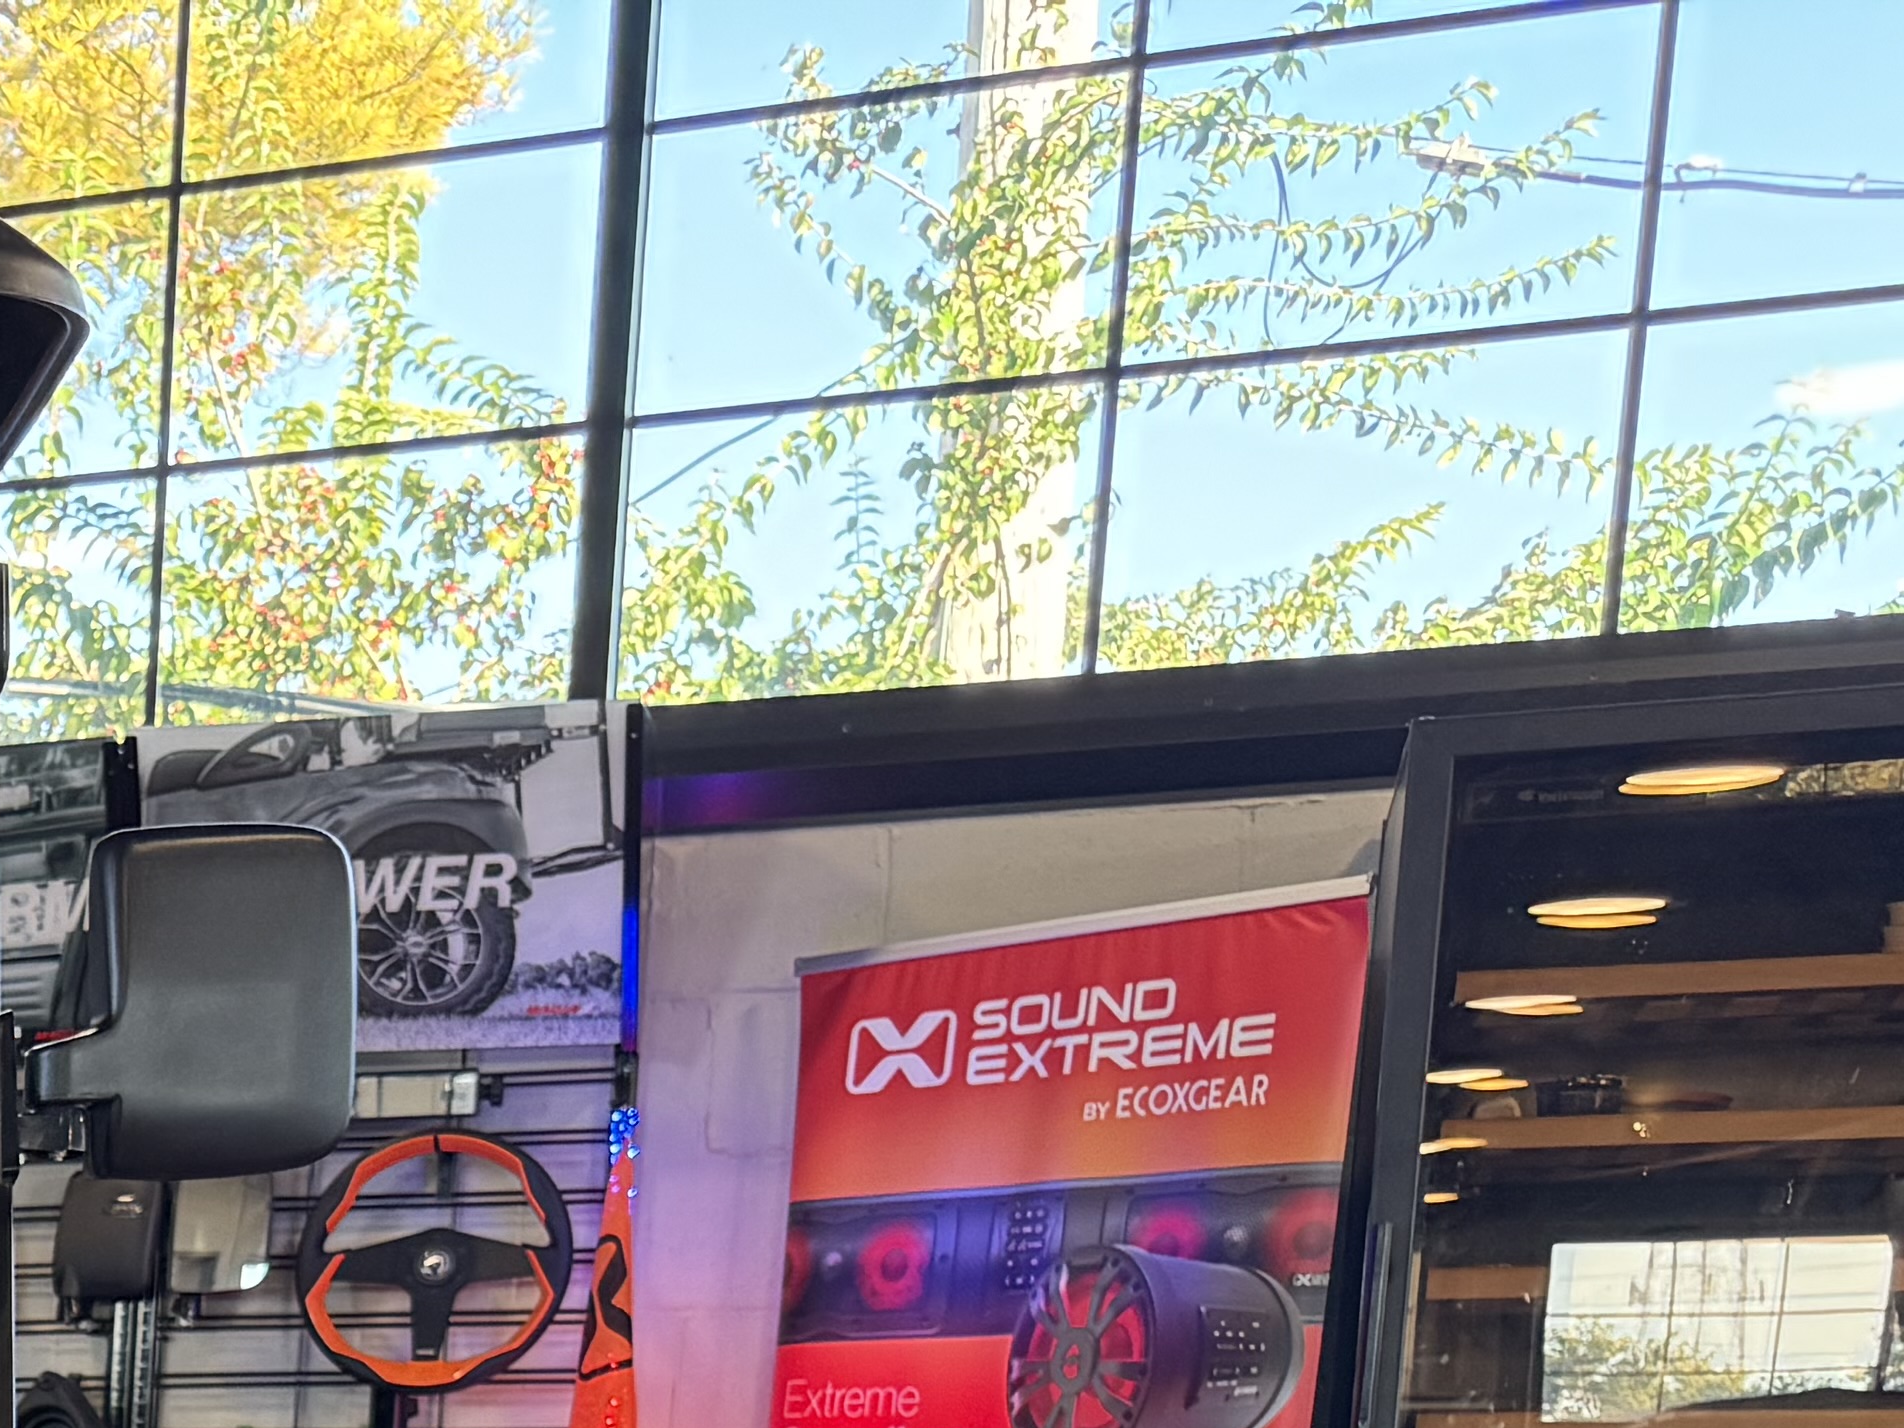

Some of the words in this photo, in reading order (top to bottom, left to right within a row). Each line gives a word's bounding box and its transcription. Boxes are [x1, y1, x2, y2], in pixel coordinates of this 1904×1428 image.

[352, 853, 519, 914] WER
[971, 977, 1178, 1041] SOUND
[965, 1012, 1277, 1086] EXTREME
[1082, 1101, 1110, 1122] BY
[1114, 1073, 1270, 1119] ECOXGEAR
[782, 1378, 922, 1419] Extreme
